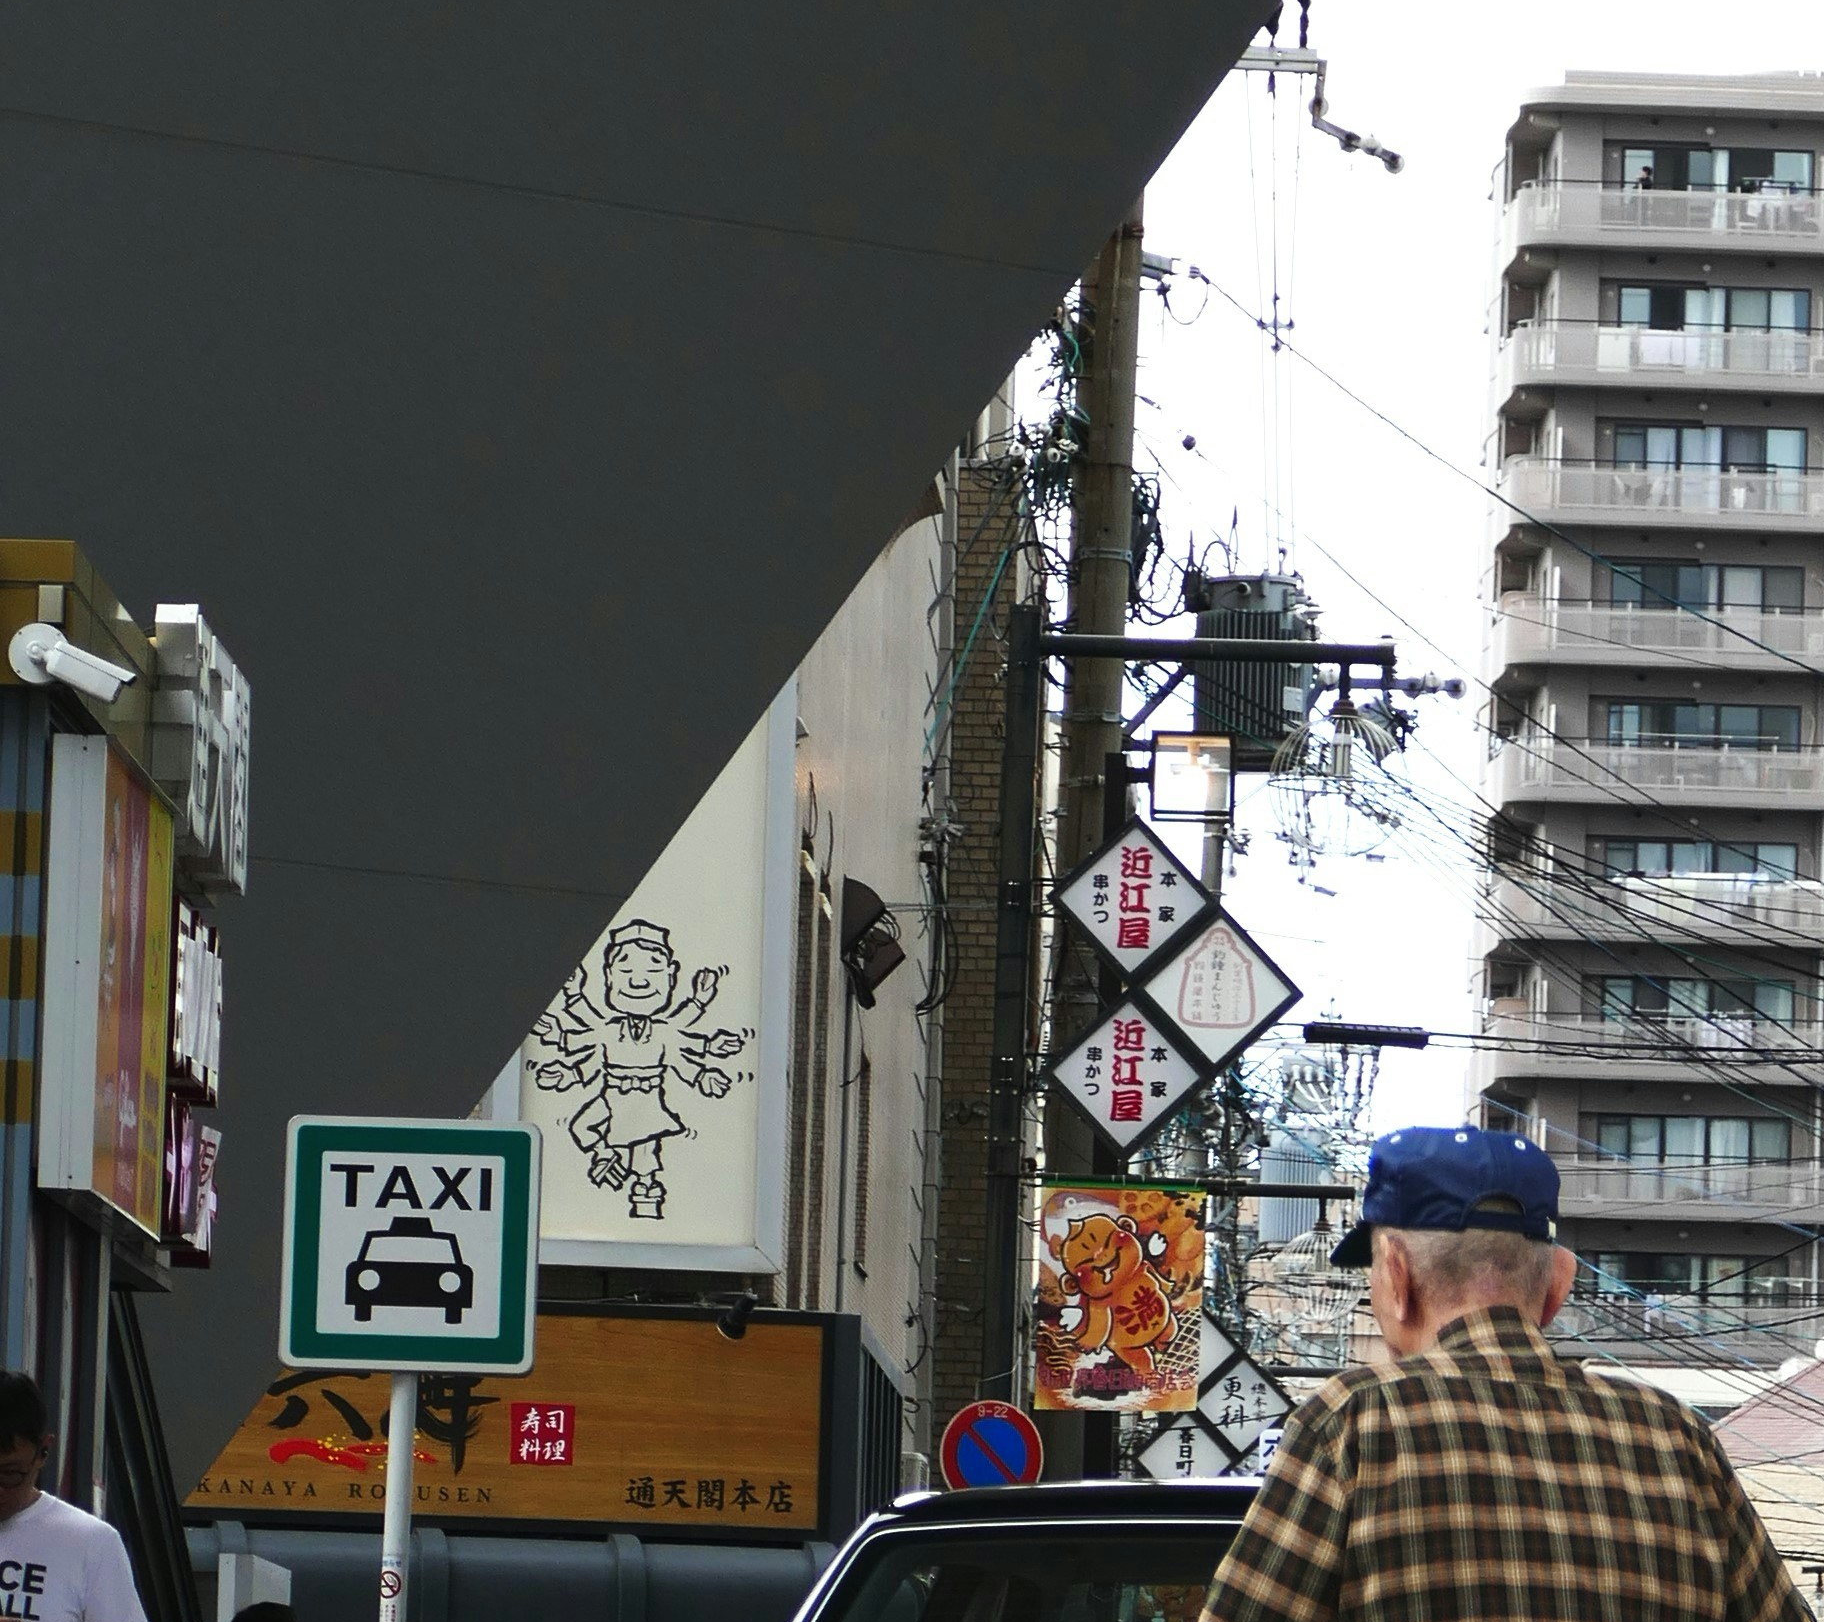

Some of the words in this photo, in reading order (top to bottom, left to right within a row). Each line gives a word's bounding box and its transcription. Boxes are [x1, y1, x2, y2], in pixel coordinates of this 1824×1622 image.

[1093, 874, 1109, 923] 串かつ
[1117, 846, 1153, 949] 近江屋
[1158, 872, 1178, 922] 本家
[1085, 1047, 1103, 1096] 串かつ
[1109, 1019, 1146, 1122] 近江屋
[1150, 1046, 1168, 1097] 本家
[330, 1164, 492, 1211] TAXI
[520, 1407, 566, 1435] 寿司
[978, 1405, 1009, 1418] 9-22
[1219, 1377, 1249, 1430] 更科
[519, 1438, 566, 1462] 料理
[349, 1483, 493, 1503] ROUSEN
[624, 1477, 794, 1514] 通天閣本店
